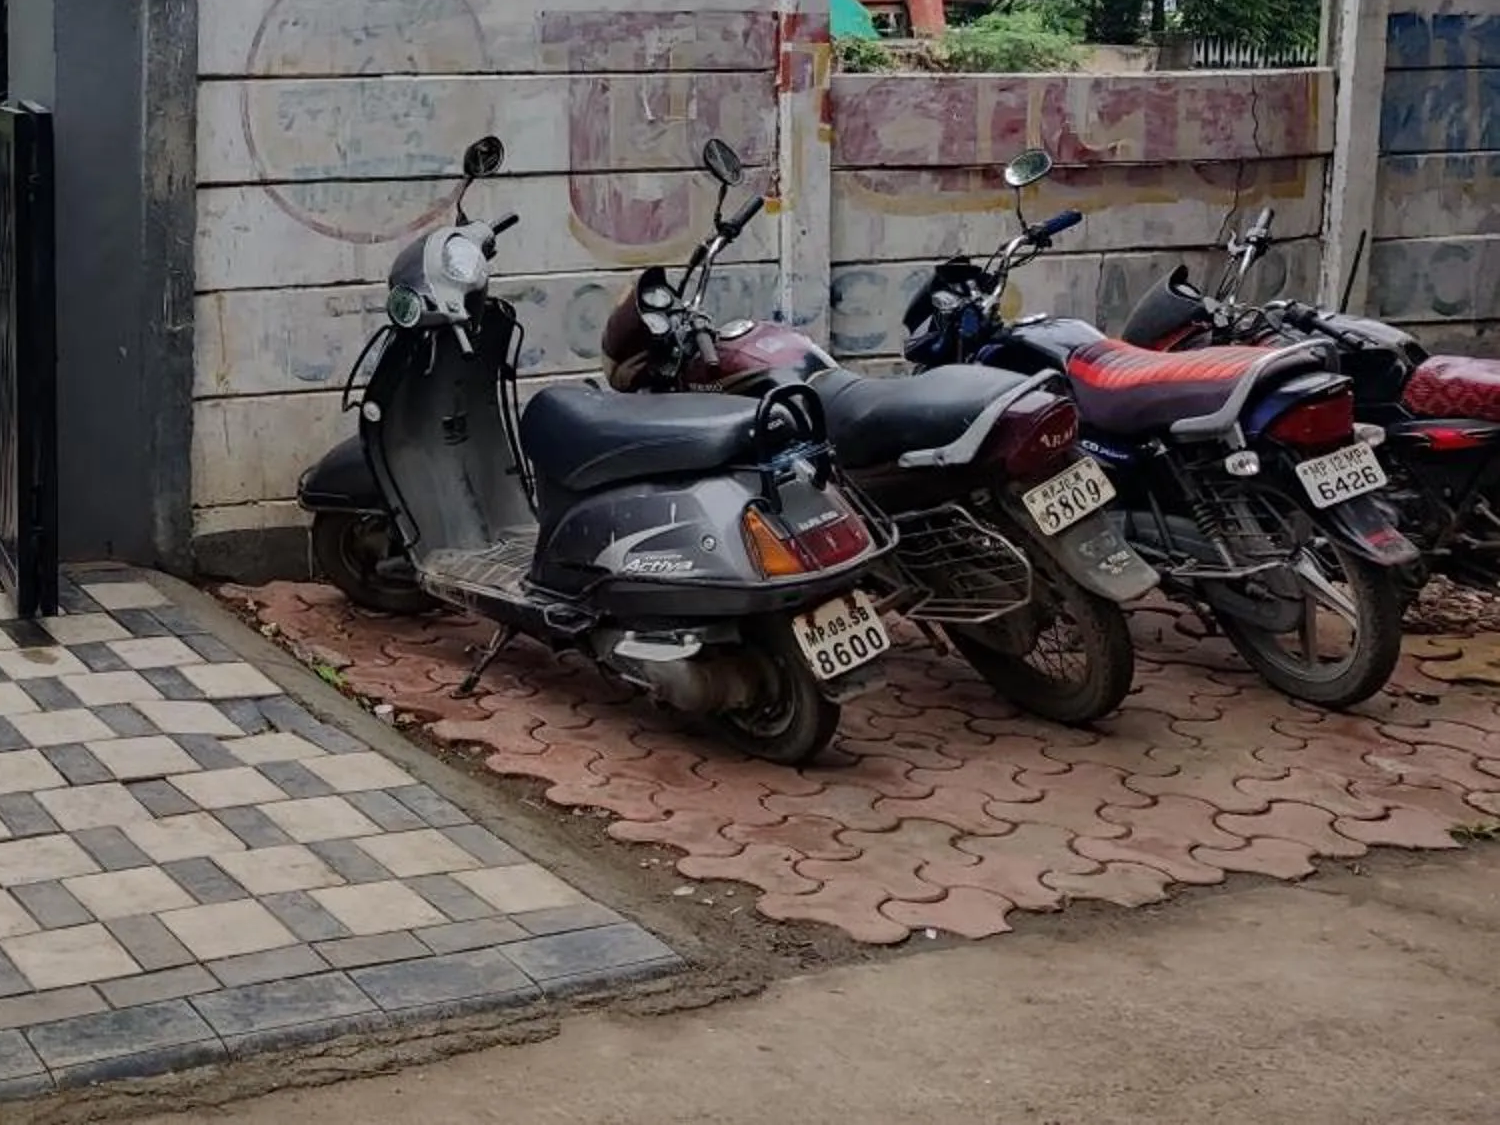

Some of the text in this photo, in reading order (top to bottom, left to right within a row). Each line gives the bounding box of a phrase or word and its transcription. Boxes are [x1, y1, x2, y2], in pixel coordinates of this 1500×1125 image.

[1044, 478, 1102, 529] 5809
[1317, 465, 1379, 501] 6426
[816, 626, 884, 675] 8600
